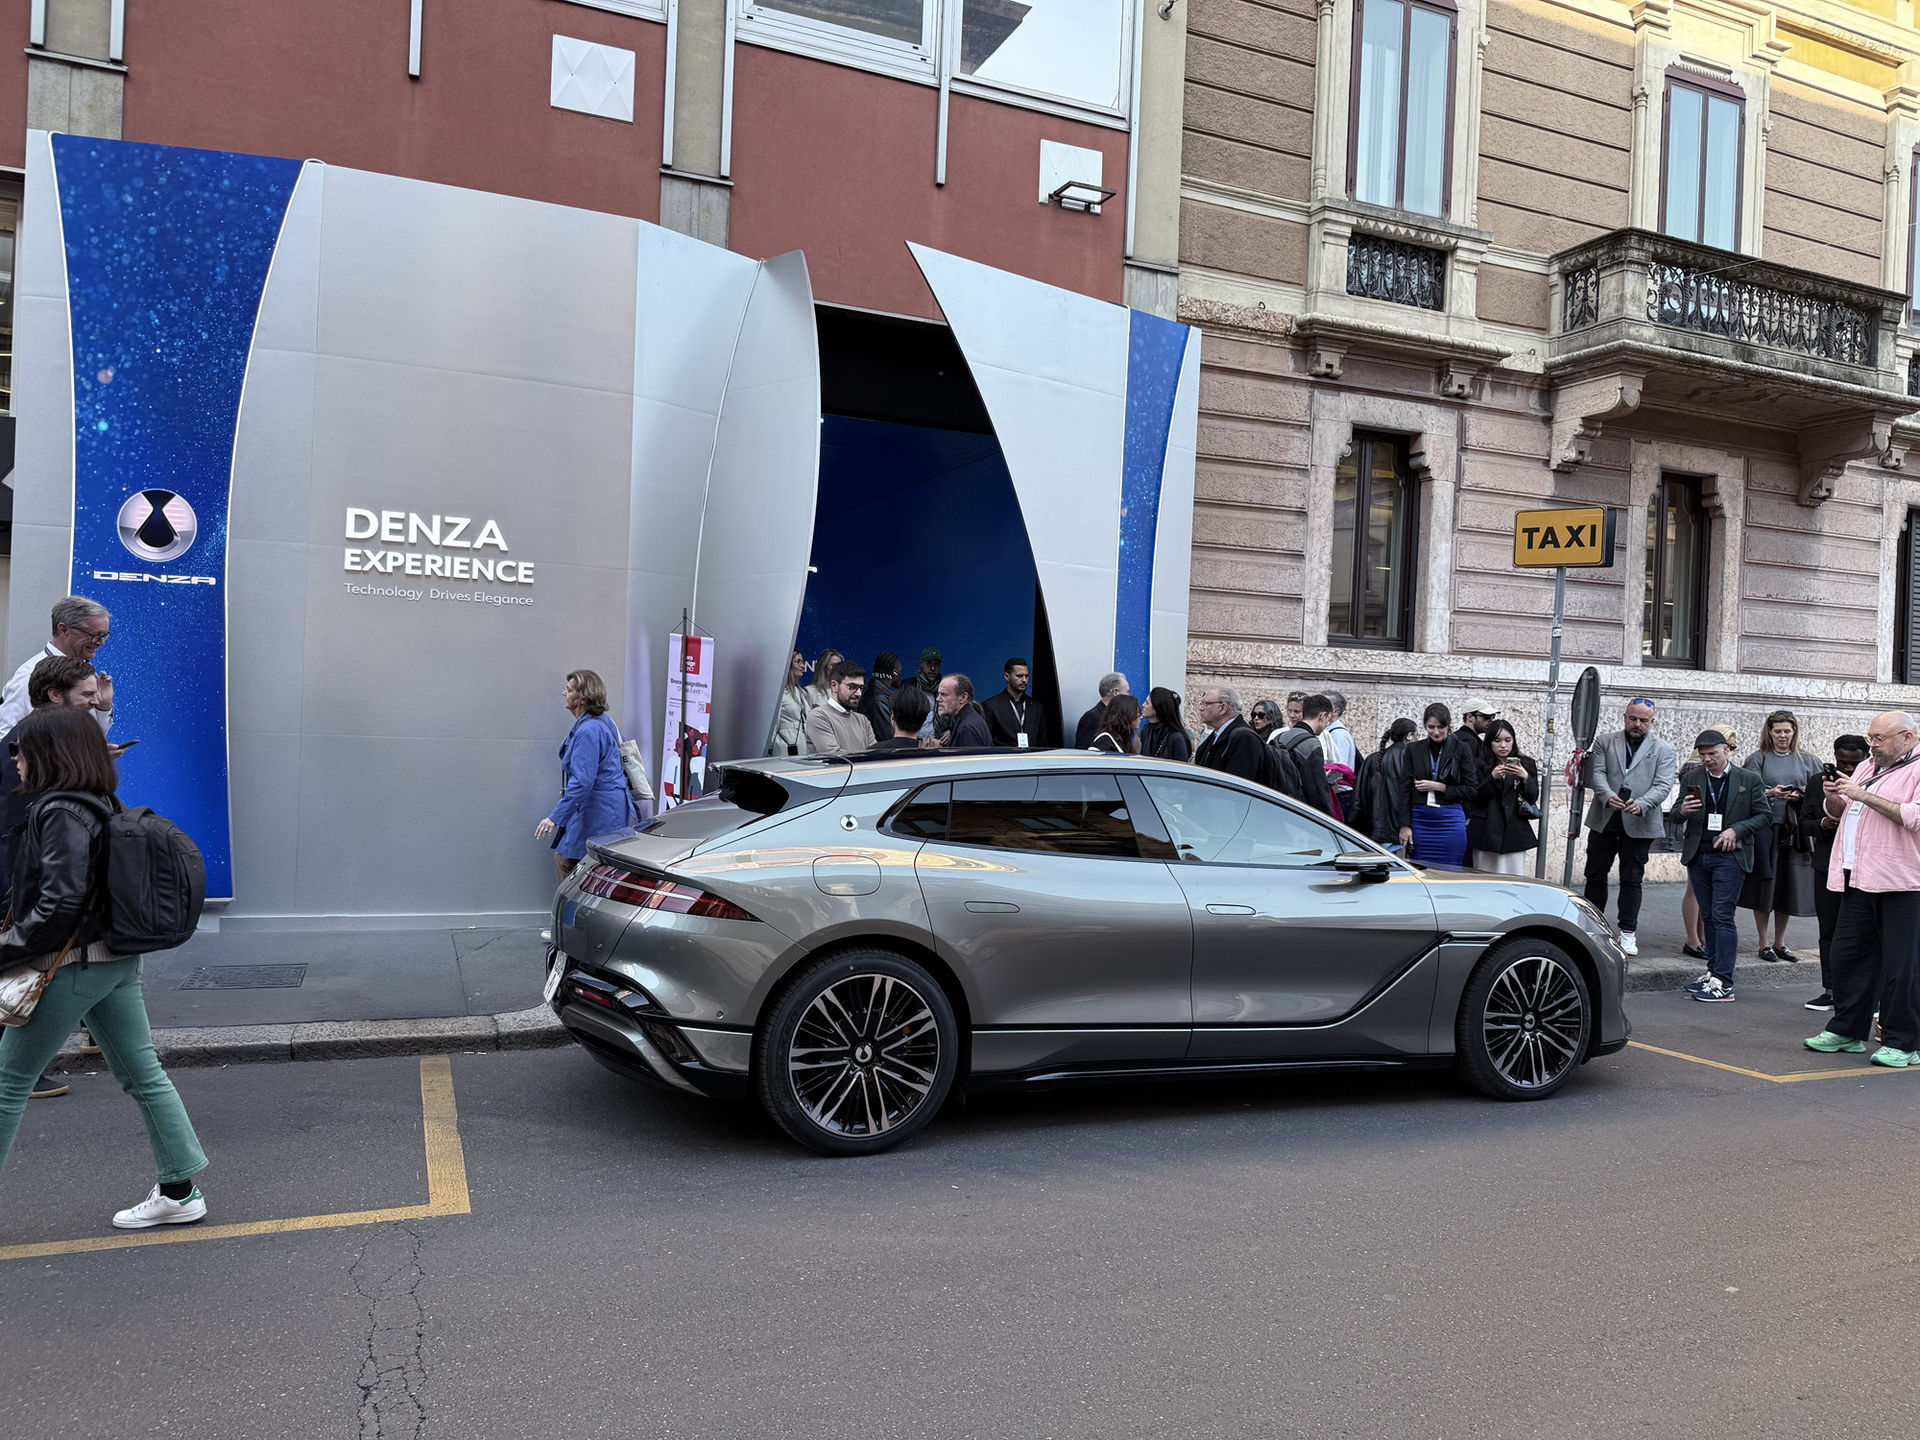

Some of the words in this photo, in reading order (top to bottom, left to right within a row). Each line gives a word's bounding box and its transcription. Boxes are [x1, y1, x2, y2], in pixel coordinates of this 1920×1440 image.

[345, 507, 509, 552] DENZA
[1522, 524, 1597, 549] TAXI
[93, 570, 216, 585] DENZA
[344, 548, 535, 584] EXPERIENCE
[344, 582, 424, 600] Technology
[430, 588, 471, 602] Drives
[474, 592, 534, 606] Elegance
